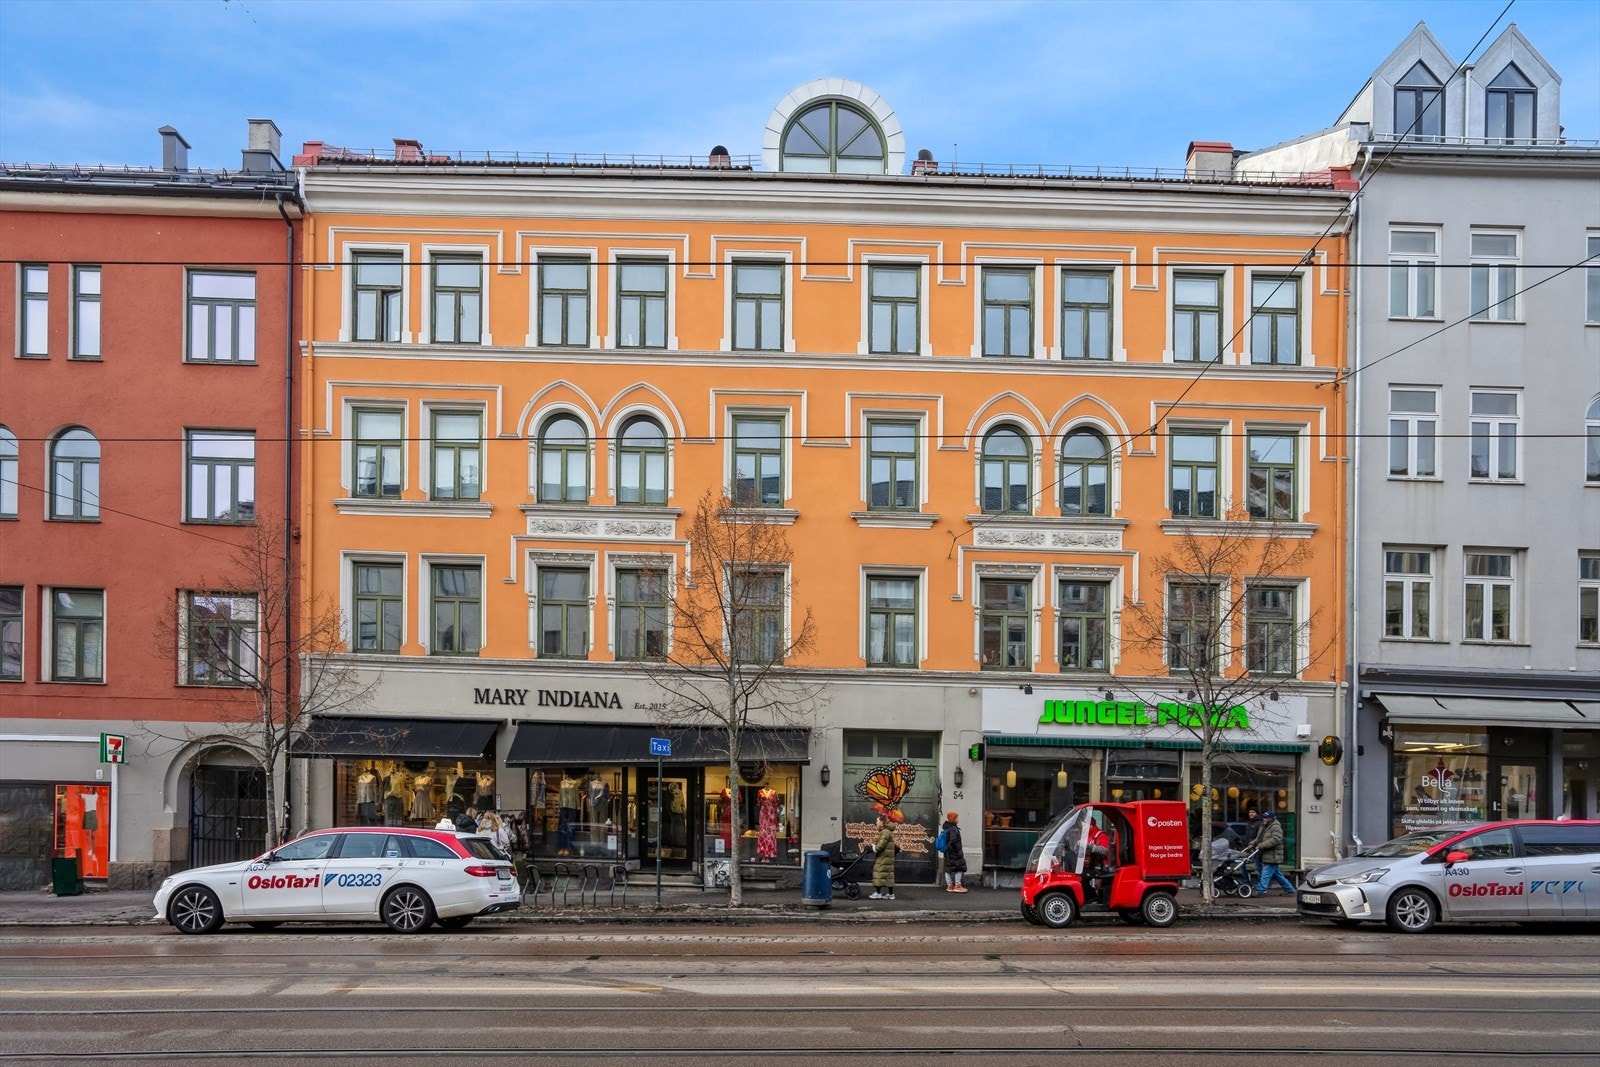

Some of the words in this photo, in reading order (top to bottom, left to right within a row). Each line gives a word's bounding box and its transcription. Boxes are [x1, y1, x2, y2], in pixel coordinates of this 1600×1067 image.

[473, 687, 529, 705] MARY
[537, 689, 623, 709] INDIANA
[649, 702, 667, 711] 2015
[1039, 700, 1152, 726] JUNGEL
[1157, 702, 1250, 729] PIZZA
[652, 741, 670, 752] Taxi
[1421, 769, 1452, 791] Bella
[953, 790, 964, 800] 54
[1445, 867, 1470, 876] A430
[247, 873, 321, 890] OsloTaxi
[338, 873, 382, 887] 02323
[1448, 881, 1525, 897] OsloTaxi
